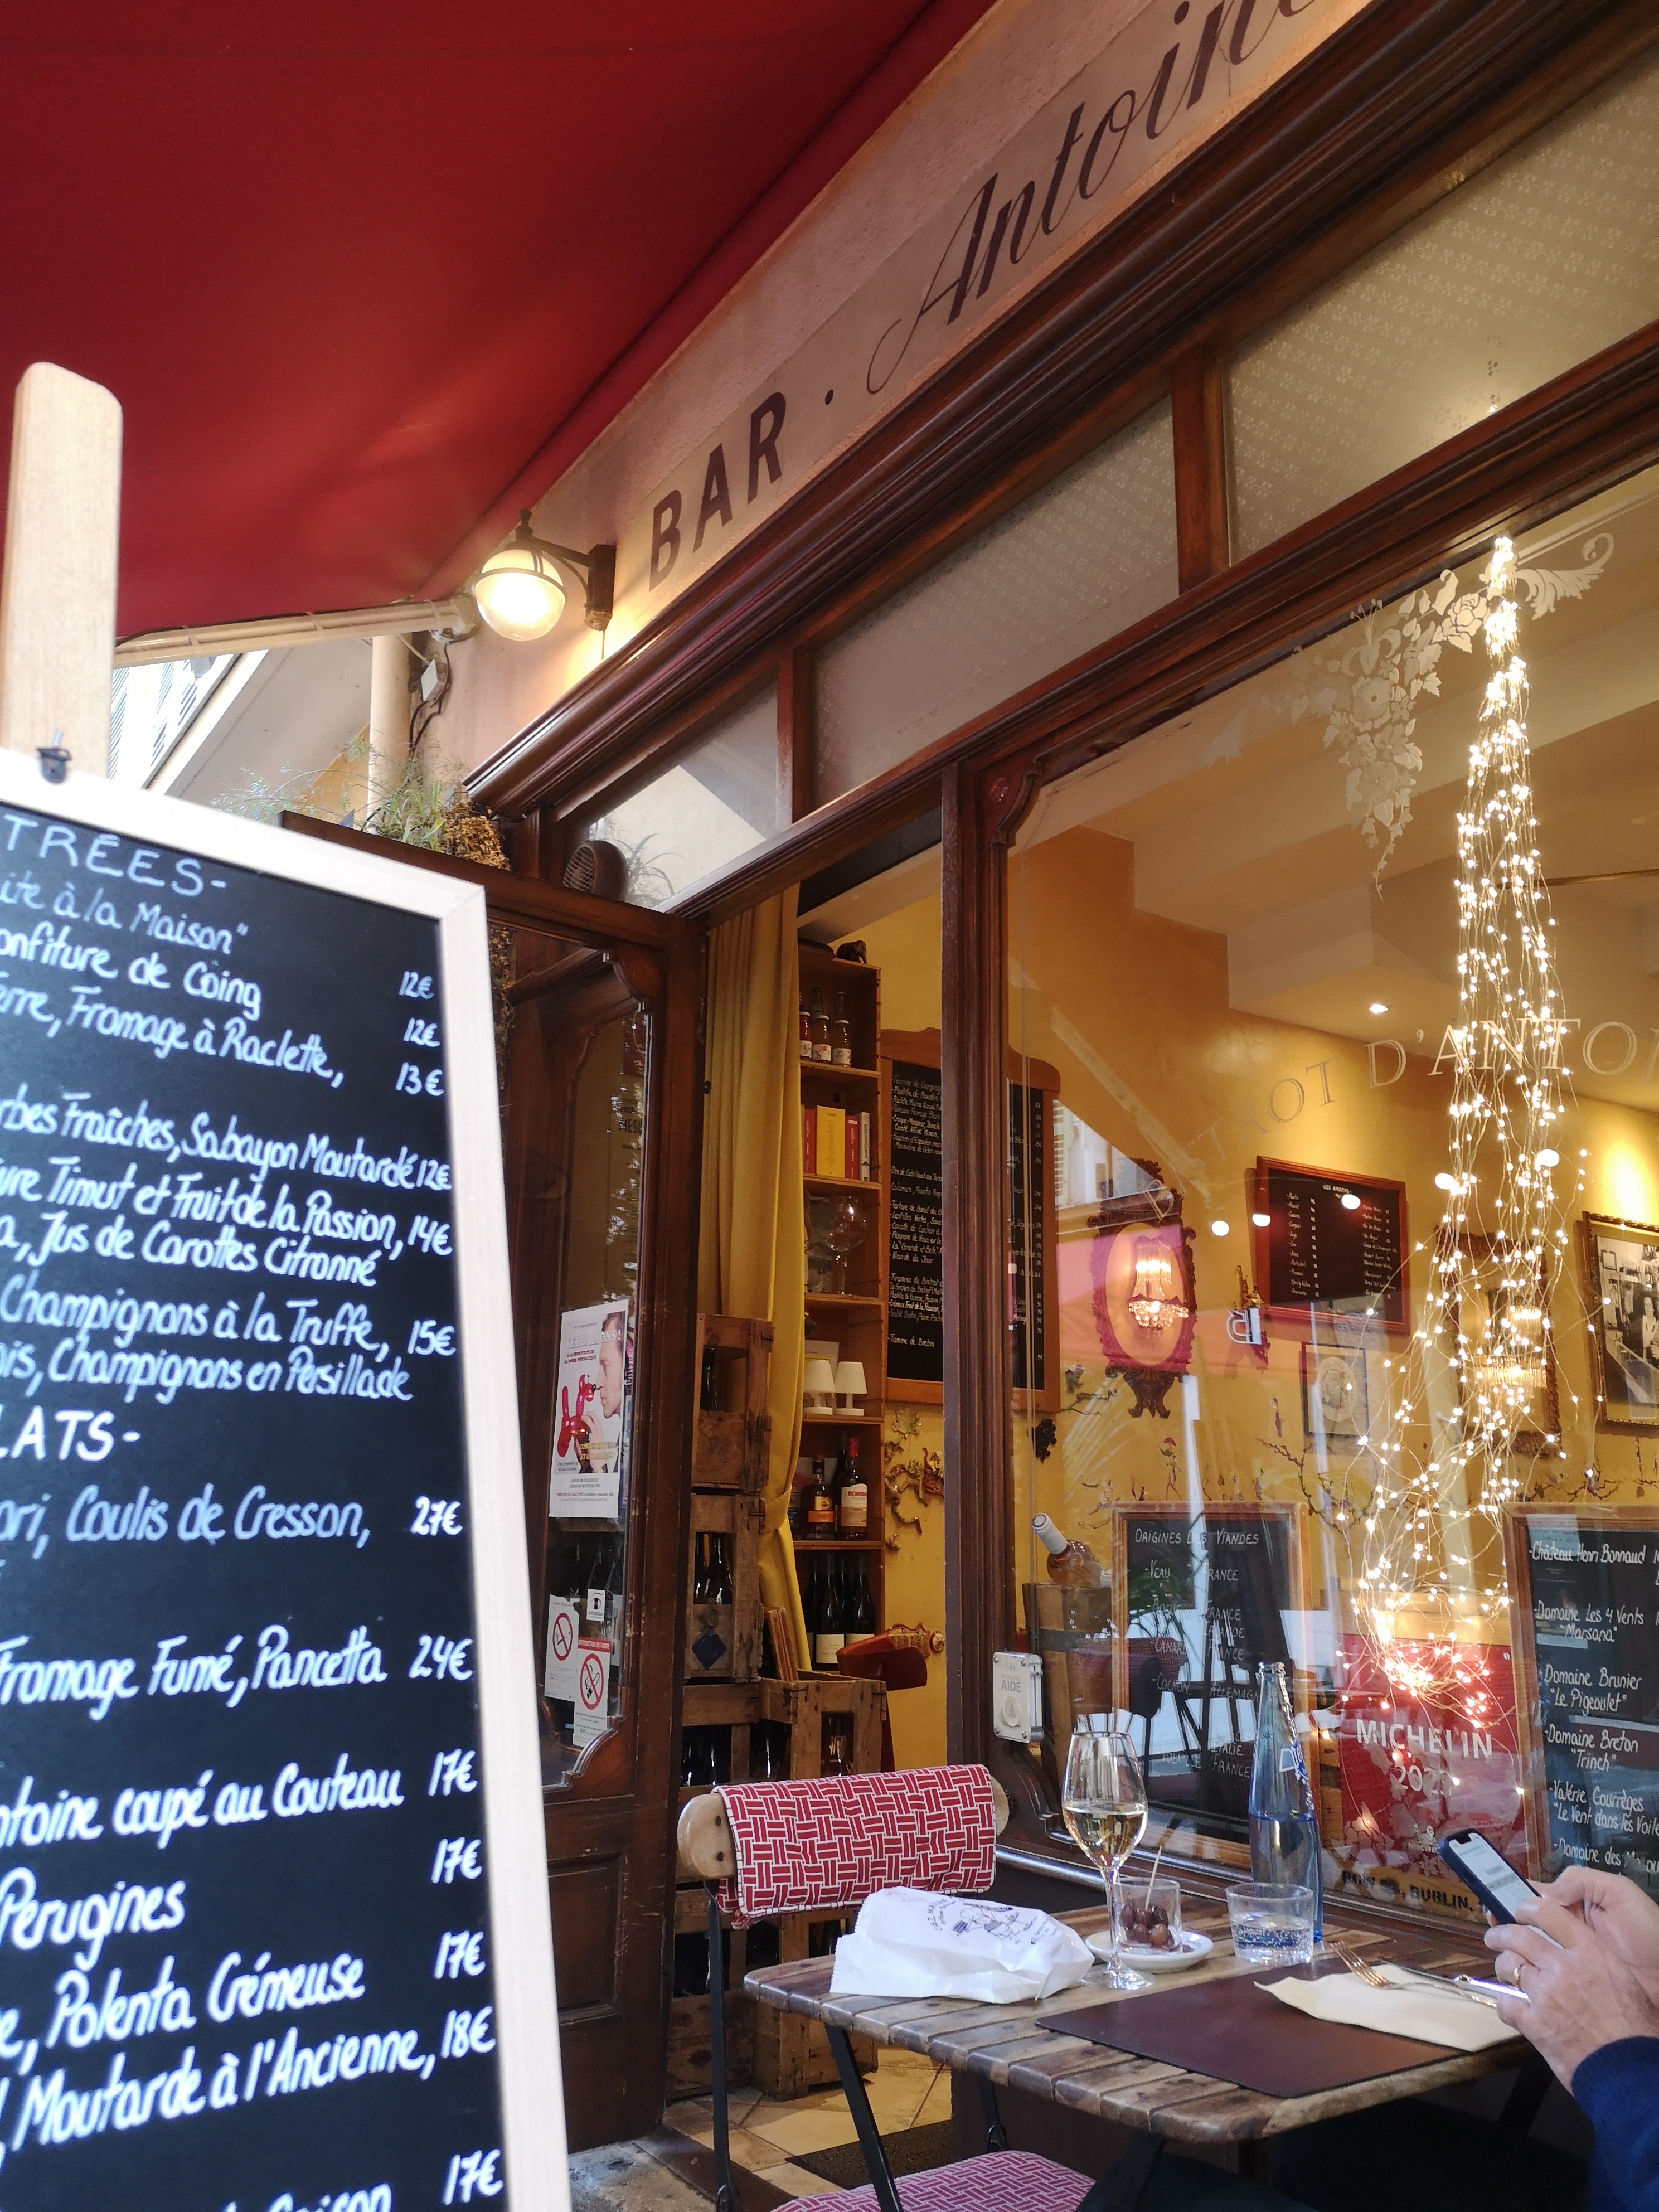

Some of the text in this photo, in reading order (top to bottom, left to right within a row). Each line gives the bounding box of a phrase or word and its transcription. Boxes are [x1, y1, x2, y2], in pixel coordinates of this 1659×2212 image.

[649, 391, 787, 593] BAR
[54, 881, 81, 919] à
[83, 887, 123, 930] la
[399, 971, 435, 999] 12€
[0, 971, 444, 1097] erre, Fromage à Raclette, 13€
[128, 952, 171, 988] de
[184, 961, 261, 1020] Coing
[404, 1017, 440, 1047] 12€
[181, 1112, 298, 1183] Sabayon
[416, 1158, 452, 1191] 12€
[47, 1156, 453, 1260] Timut et Fruit de la Passion, 14€
[27, 1210, 90, 1267] Jus
[95, 1214, 135, 1260] de
[142, 1220, 258, 1272] Carottes
[264, 1235, 377, 1287] Citronné
[0, 1269, 457, 1363] Champignons à la Truffe, 15€
[909, 1336, 916, 1345] de
[918, 1337, 934, 1347] Brebis
[48, 1336, 244, 1405] Champignons
[246, 1361, 282, 1392] en
[66, 1483, 169, 1541] Coulis
[178, 1483, 226, 1542] de
[234, 1485, 371, 1548] Cresson,
[410, 1496, 464, 1536] 27€
[1186, 1530, 1207, 1545] DS
[1207, 1568, 1239, 1582] RANCE
[1587, 1603, 1602, 1623] Les
[1605, 1608, 1613, 1623] 4
[1617, 1604, 1644, 1625] Vents
[0, 1624, 474, 1720] Fromage Fumé, Pancetta 24€
[1001, 1680, 1021, 1692] AIDE
[1544, 1663, 1643, 1690] Domaine Brunier
[1212, 1753, 1250, 1779] FRANCE
[1356, 1719, 1493, 1760] MICHELIN
[1600, 1729, 1639, 1754] Breton
[113, 1769, 215, 1849] coupé
[214, 1782, 267, 1825] au
[272, 1752, 405, 1818] Couteau
[428, 1749, 478, 1797] 17€
[1571, 1804, 1592, 1825] Vent
[1595, 1809, 1618, 1830] dans
[1621, 1813, 1633, 1832] les
[1604, 1846, 1621, 1867] des
[0, 1838, 483, 1972] Perugines 17€
[46, 1954, 197, 2049] Polenta
[208, 1951, 366, 2022] Crémeuse
[434, 1930, 486, 1980] 17€
[12, 2045, 206, 2152] Moutarde
[210, 2051, 241, 2109] à
[244, 2026, 436, 2101] l'Ancienne,
[441, 2006, 496, 2059] 18€
[443, 2148, 503, 2205] 17€
